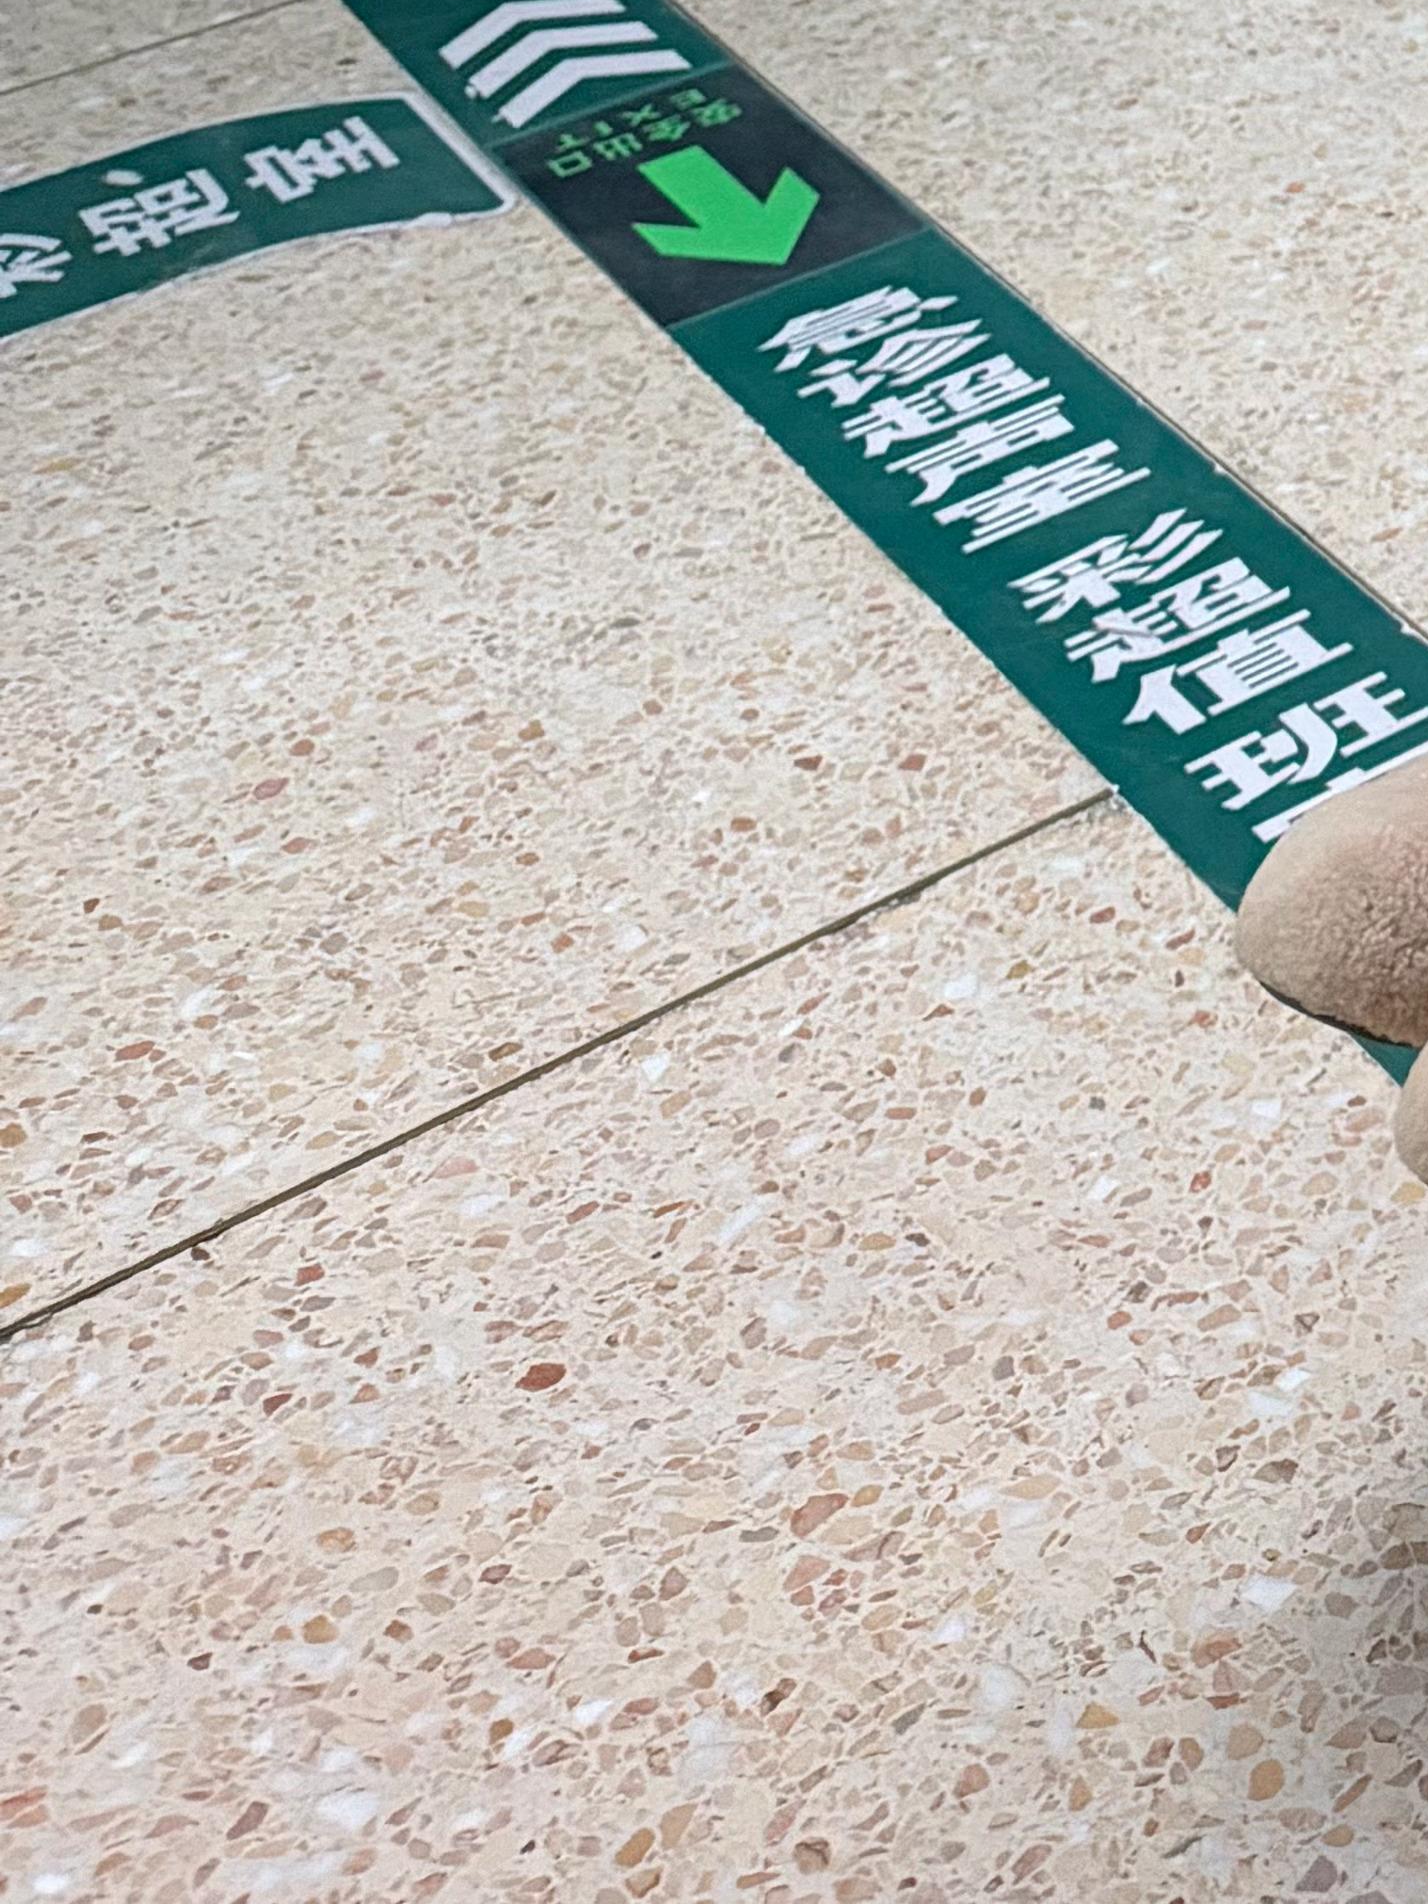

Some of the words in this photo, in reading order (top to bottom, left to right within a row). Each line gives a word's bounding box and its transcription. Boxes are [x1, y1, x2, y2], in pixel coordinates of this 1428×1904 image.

[547, 98, 743, 178] 安全出口
[759, 285, 1151, 555] 急诊超声室
